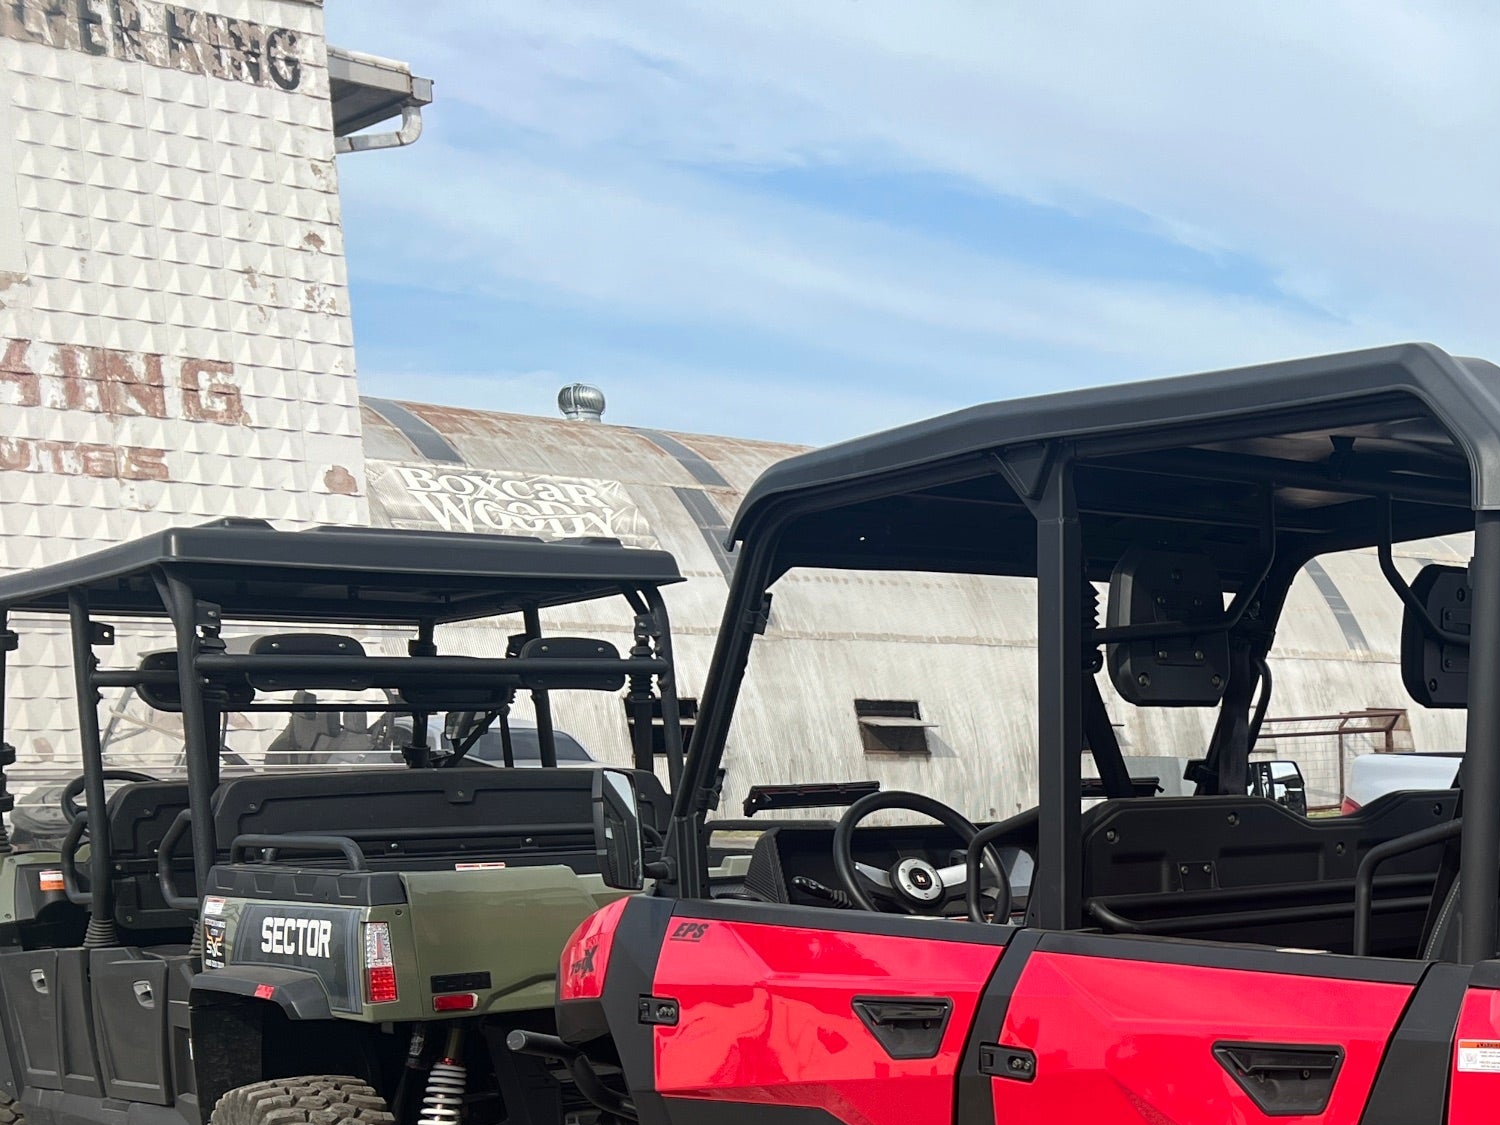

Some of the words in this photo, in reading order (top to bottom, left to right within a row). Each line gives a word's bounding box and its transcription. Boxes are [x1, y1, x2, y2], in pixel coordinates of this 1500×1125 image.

[165, 4, 301, 91] KING
[261, 916, 332, 959] SECTOR
[671, 922, 709, 939] EPS
